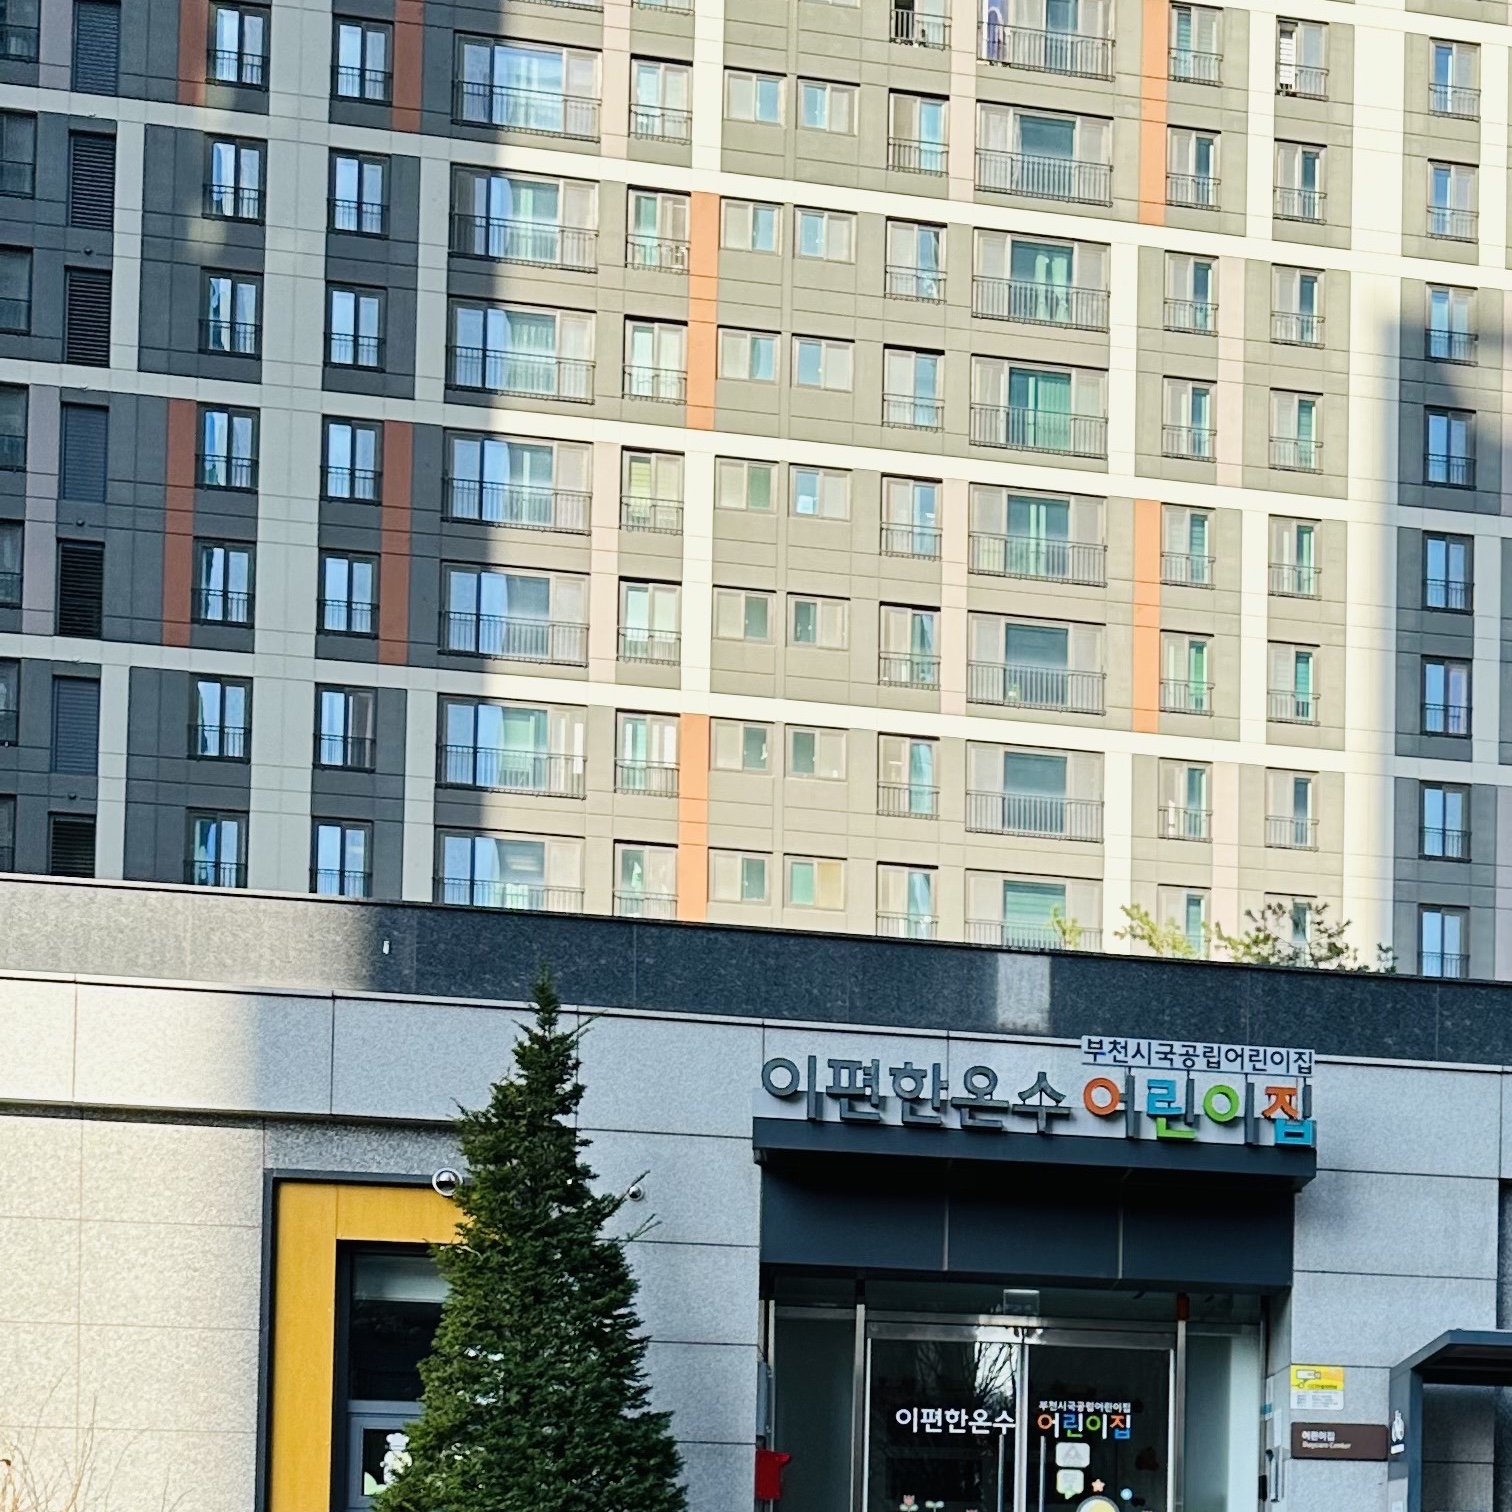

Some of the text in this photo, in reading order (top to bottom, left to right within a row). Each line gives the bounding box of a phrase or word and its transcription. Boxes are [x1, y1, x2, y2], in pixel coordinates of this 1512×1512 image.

[1083, 1038, 1313, 1075] 부천시국공립어린이집
[761, 1055, 1316, 1148] 이편한온수 어린이집
[895, 1406, 1131, 1440] 이편한온수 어린이집
